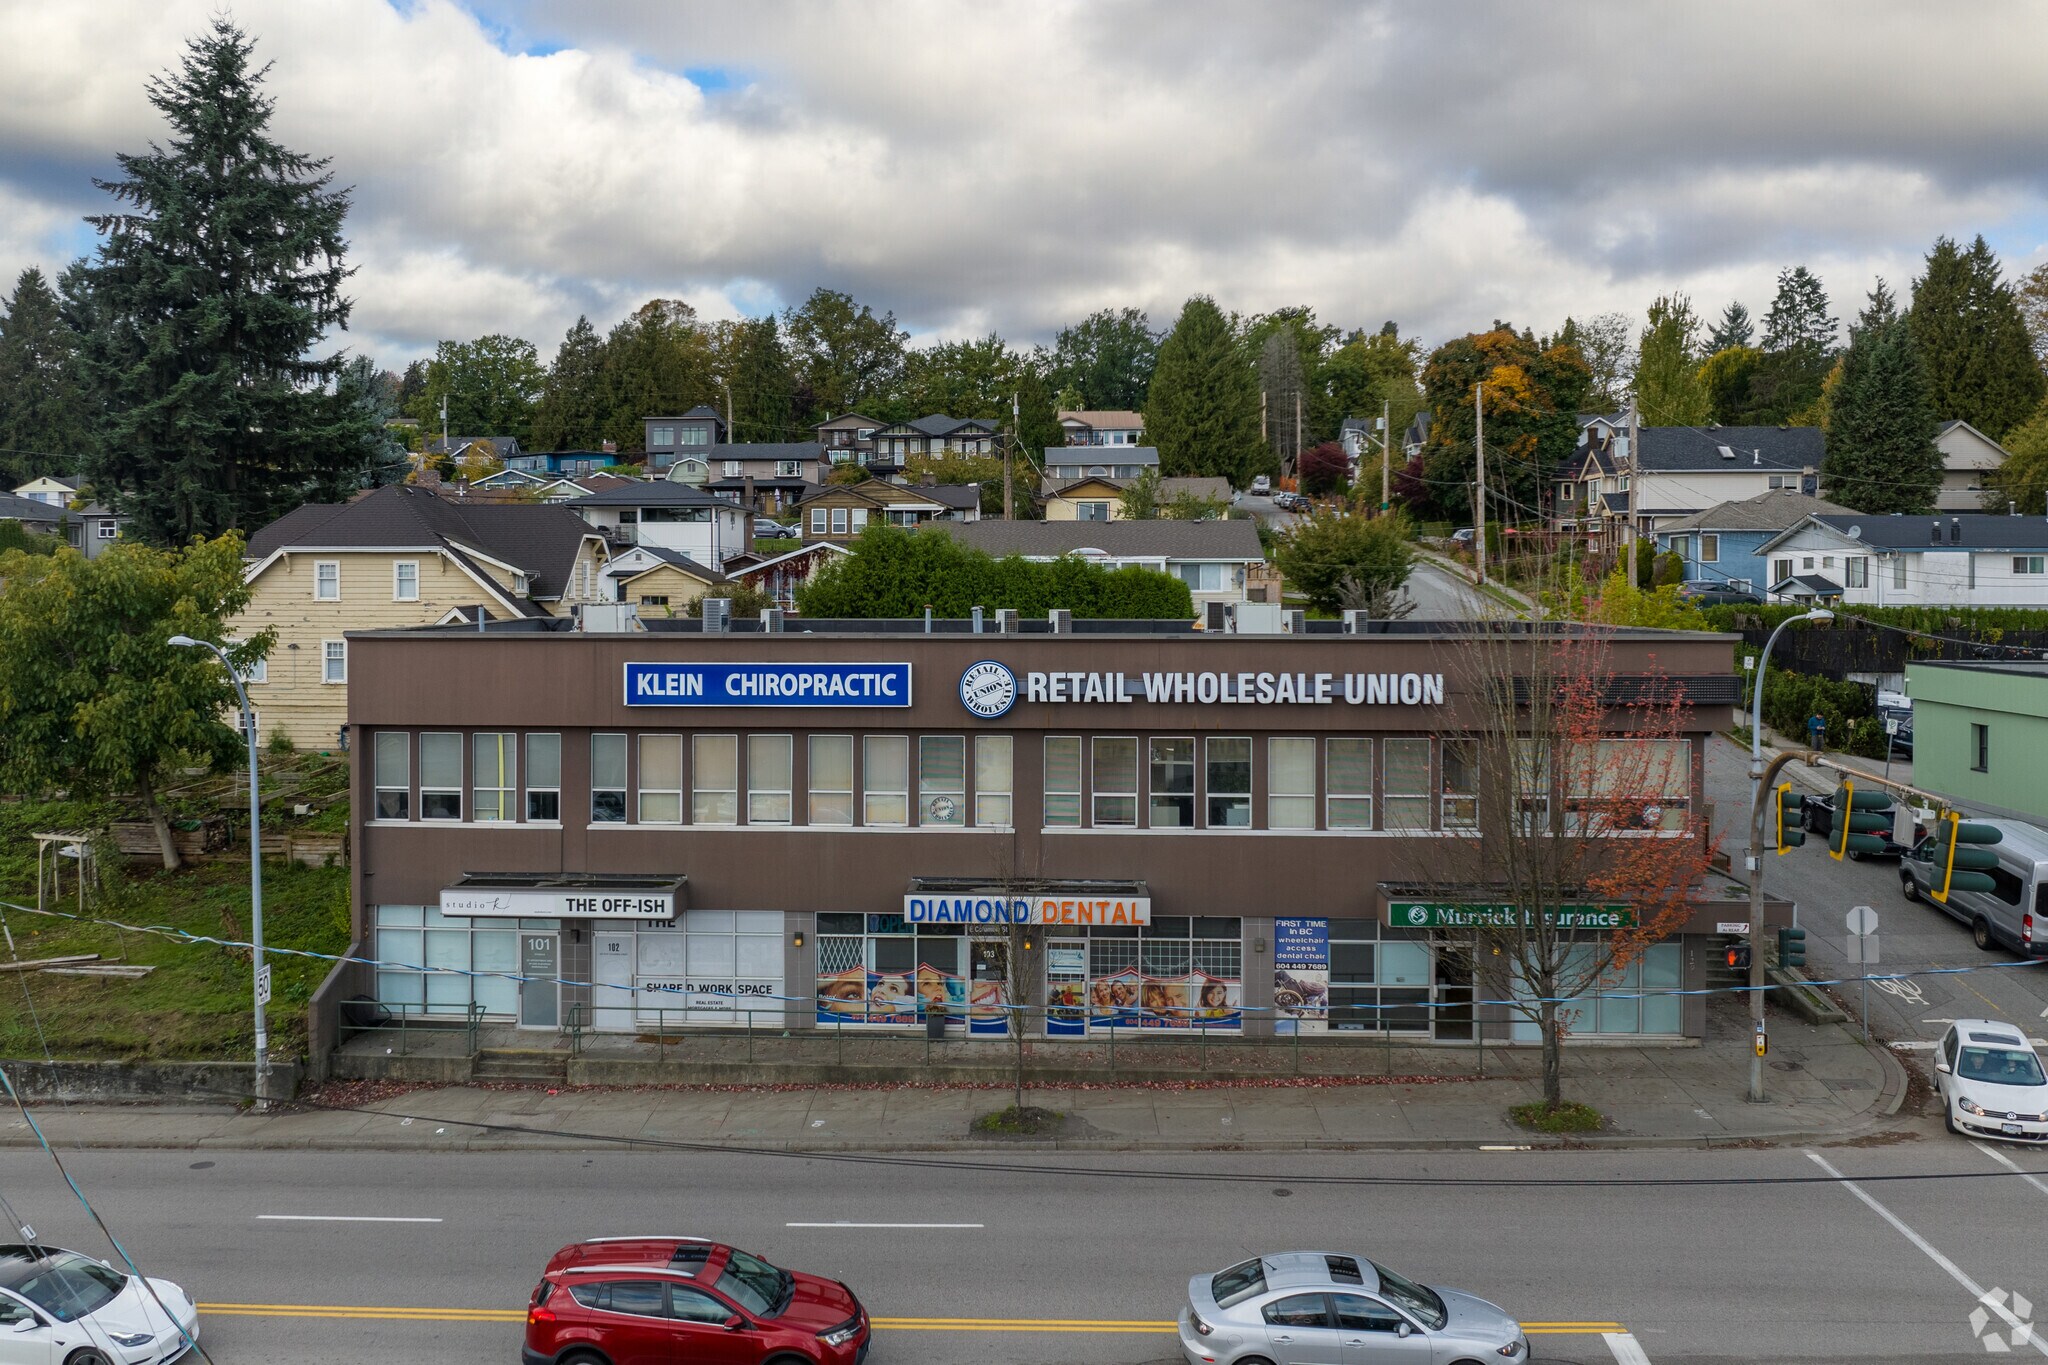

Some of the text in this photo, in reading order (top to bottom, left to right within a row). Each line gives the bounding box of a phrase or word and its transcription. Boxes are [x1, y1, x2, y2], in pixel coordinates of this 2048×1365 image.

[637, 673, 897, 696] KLEIN CHIROPRACTIC
[965, 666, 1000, 687] RETAIL
[967, 680, 1012, 713] WHOLESALE
[973, 682, 1003, 698] UNION
[1027, 672, 1444, 705] RETAIL WHOLESALE UNION
[446, 901, 485, 909] studio
[566, 898, 665, 913] THE OFF-ISH
[910, 899, 1144, 924] DIAMOND DENTAL
[1435, 907, 1620, 926] Murrick Isurance
[528, 938, 550, 950] 101
[608, 943, 620, 952] 102
[983, 950, 995, 958] 103
[258, 975, 269, 997] 50
[698, 984, 733, 994] WORK
[738, 984, 773, 994] SPACE
[1142, 1019, 1160, 1027] 449
